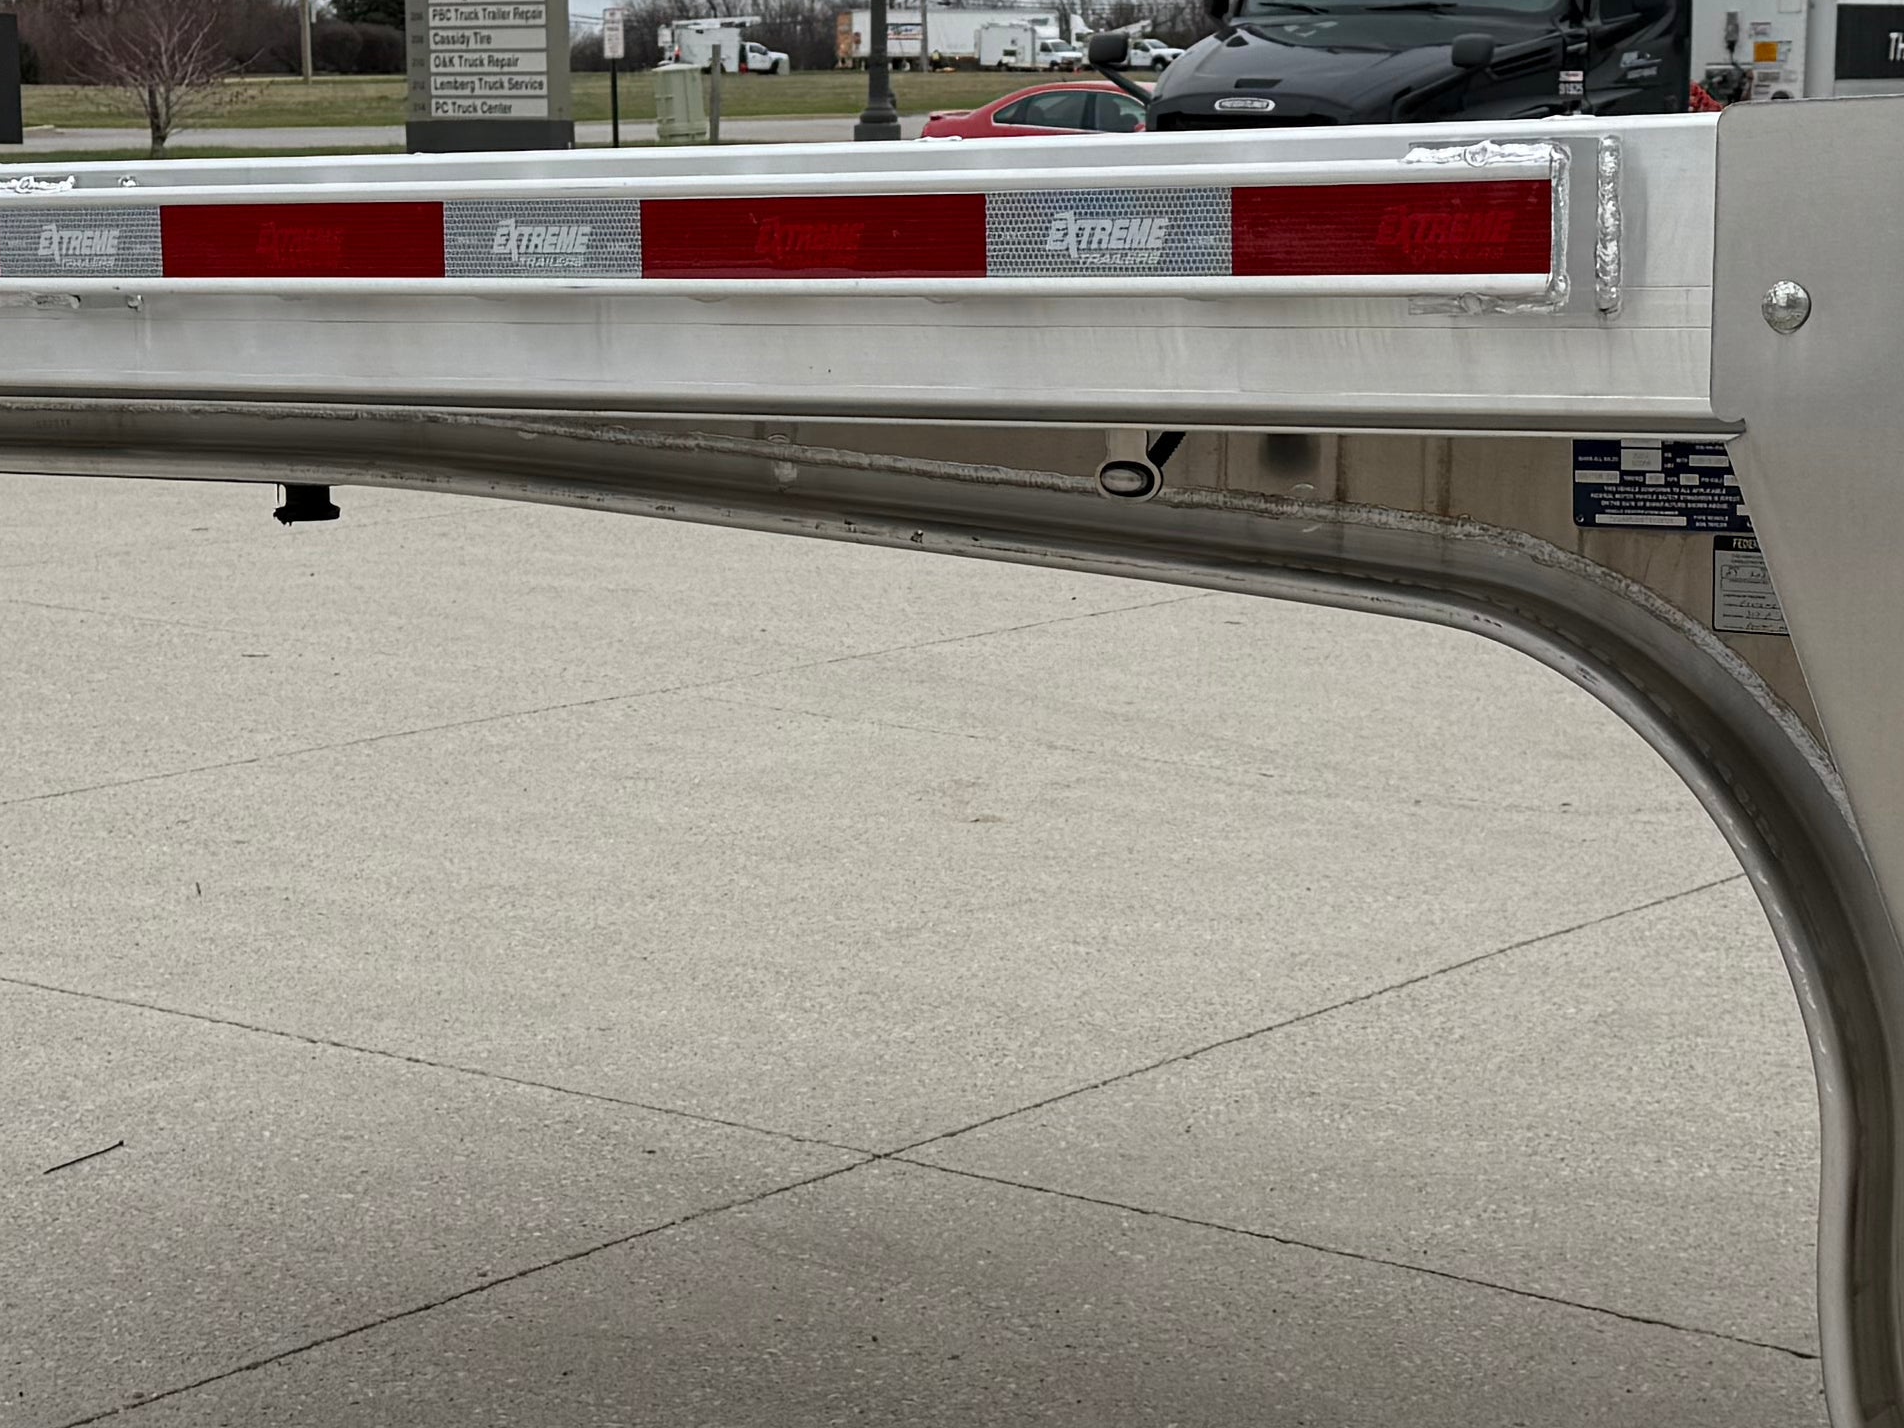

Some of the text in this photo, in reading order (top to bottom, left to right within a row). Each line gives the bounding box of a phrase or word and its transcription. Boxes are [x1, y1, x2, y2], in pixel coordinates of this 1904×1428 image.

[454, 7, 480, 21] Truck
[482, 7, 511, 21] Trailer
[513, 6, 544, 24] Repair
[433, 31, 472, 47] Cassidy
[473, 31, 492, 45] Tire
[457, 54, 485, 68] Truck
[487, 54, 520, 70] Repair
[434, 77, 475, 93] Lemberg
[478, 77, 504, 90] Truck
[507, 77, 544, 90] Service
[435, 101, 449, 114] PC
[451, 101, 478, 114] Truck
[480, 101, 513, 114] Center
[1046, 210, 1169, 258] EXTREME
[1376, 205, 1517, 254] EXTREME
[37, 223, 120, 263] EXTREME
[493, 218, 592, 261] EXTREME
